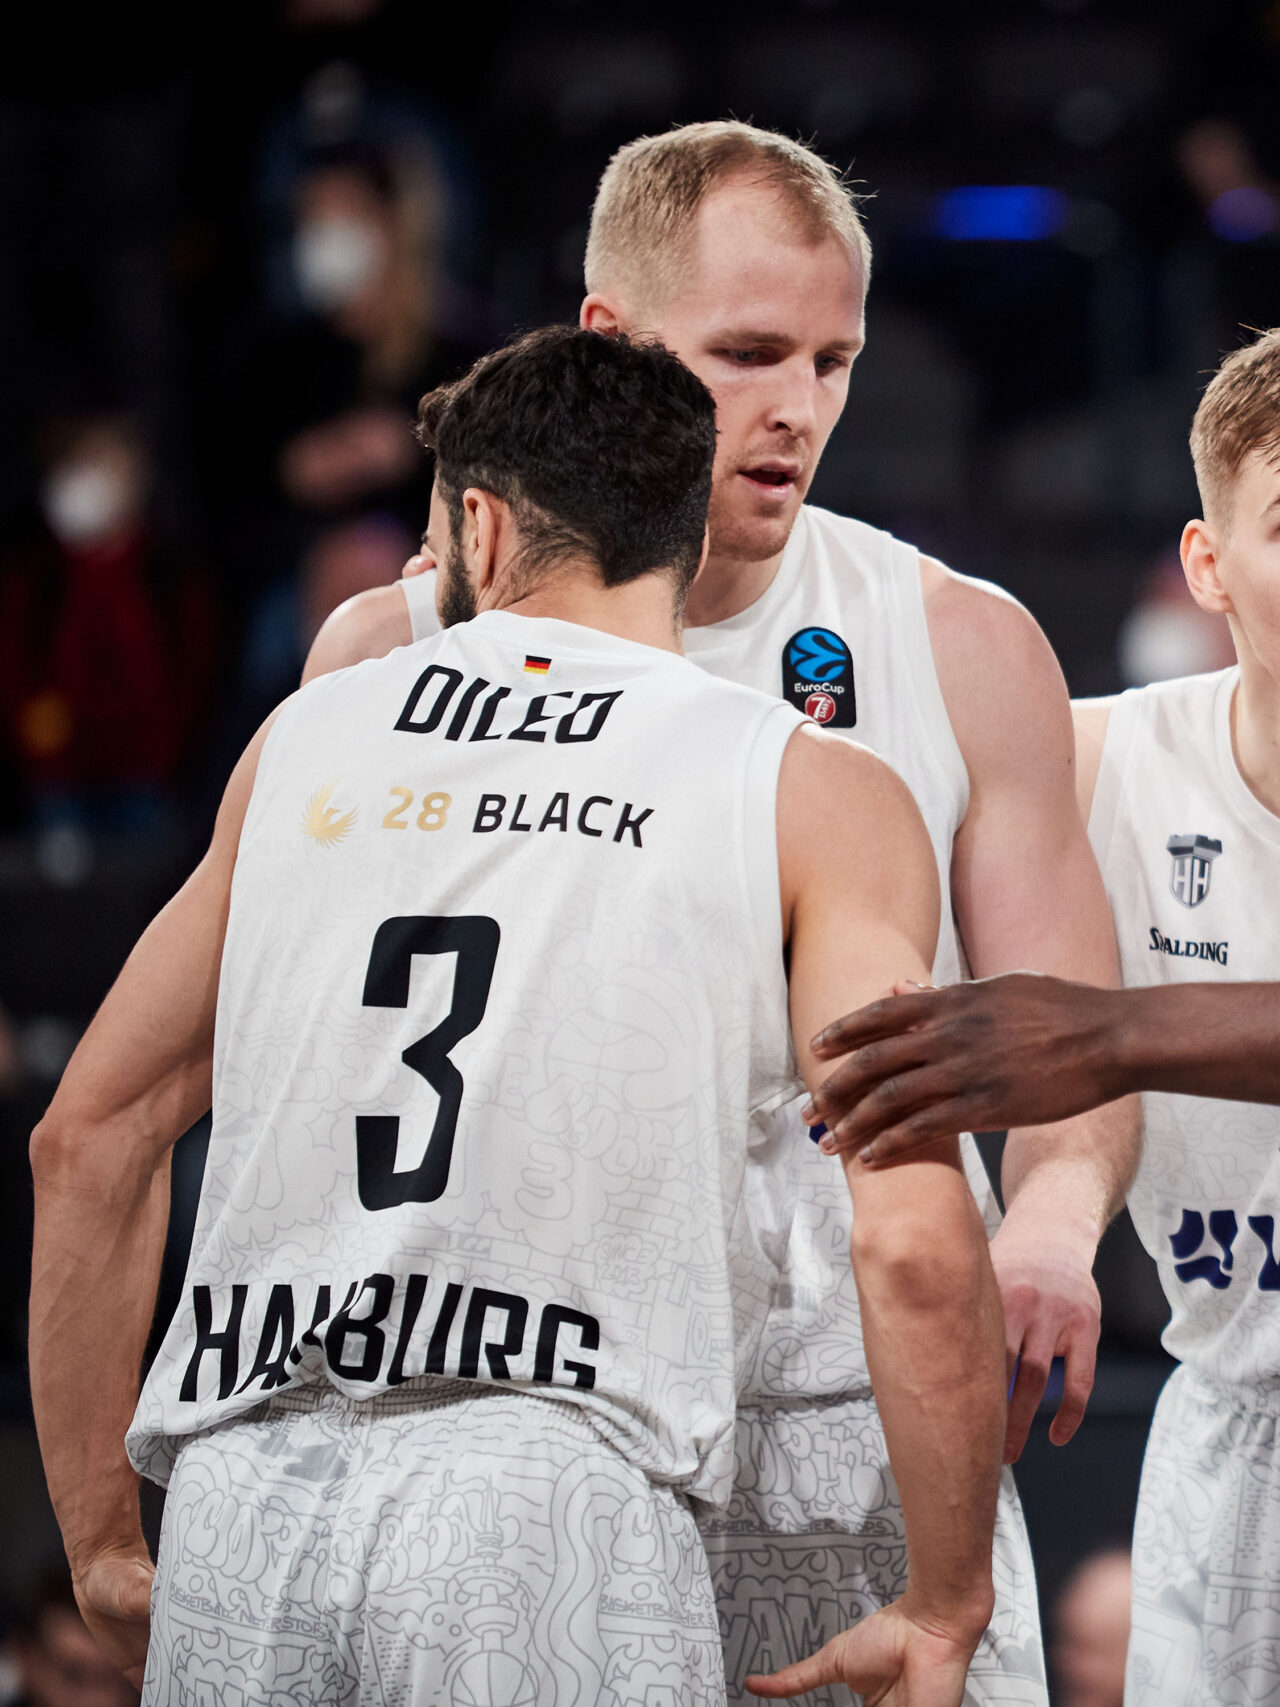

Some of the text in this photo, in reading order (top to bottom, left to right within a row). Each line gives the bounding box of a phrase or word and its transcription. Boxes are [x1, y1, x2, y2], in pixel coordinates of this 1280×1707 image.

[393, 664, 625, 744] DILEO
[794, 682, 845, 695] EuroCup
[382, 786, 655, 848] 28 BLACK
[1149, 926, 1229, 966] SPALDING
[356, 915, 501, 1212] 3
